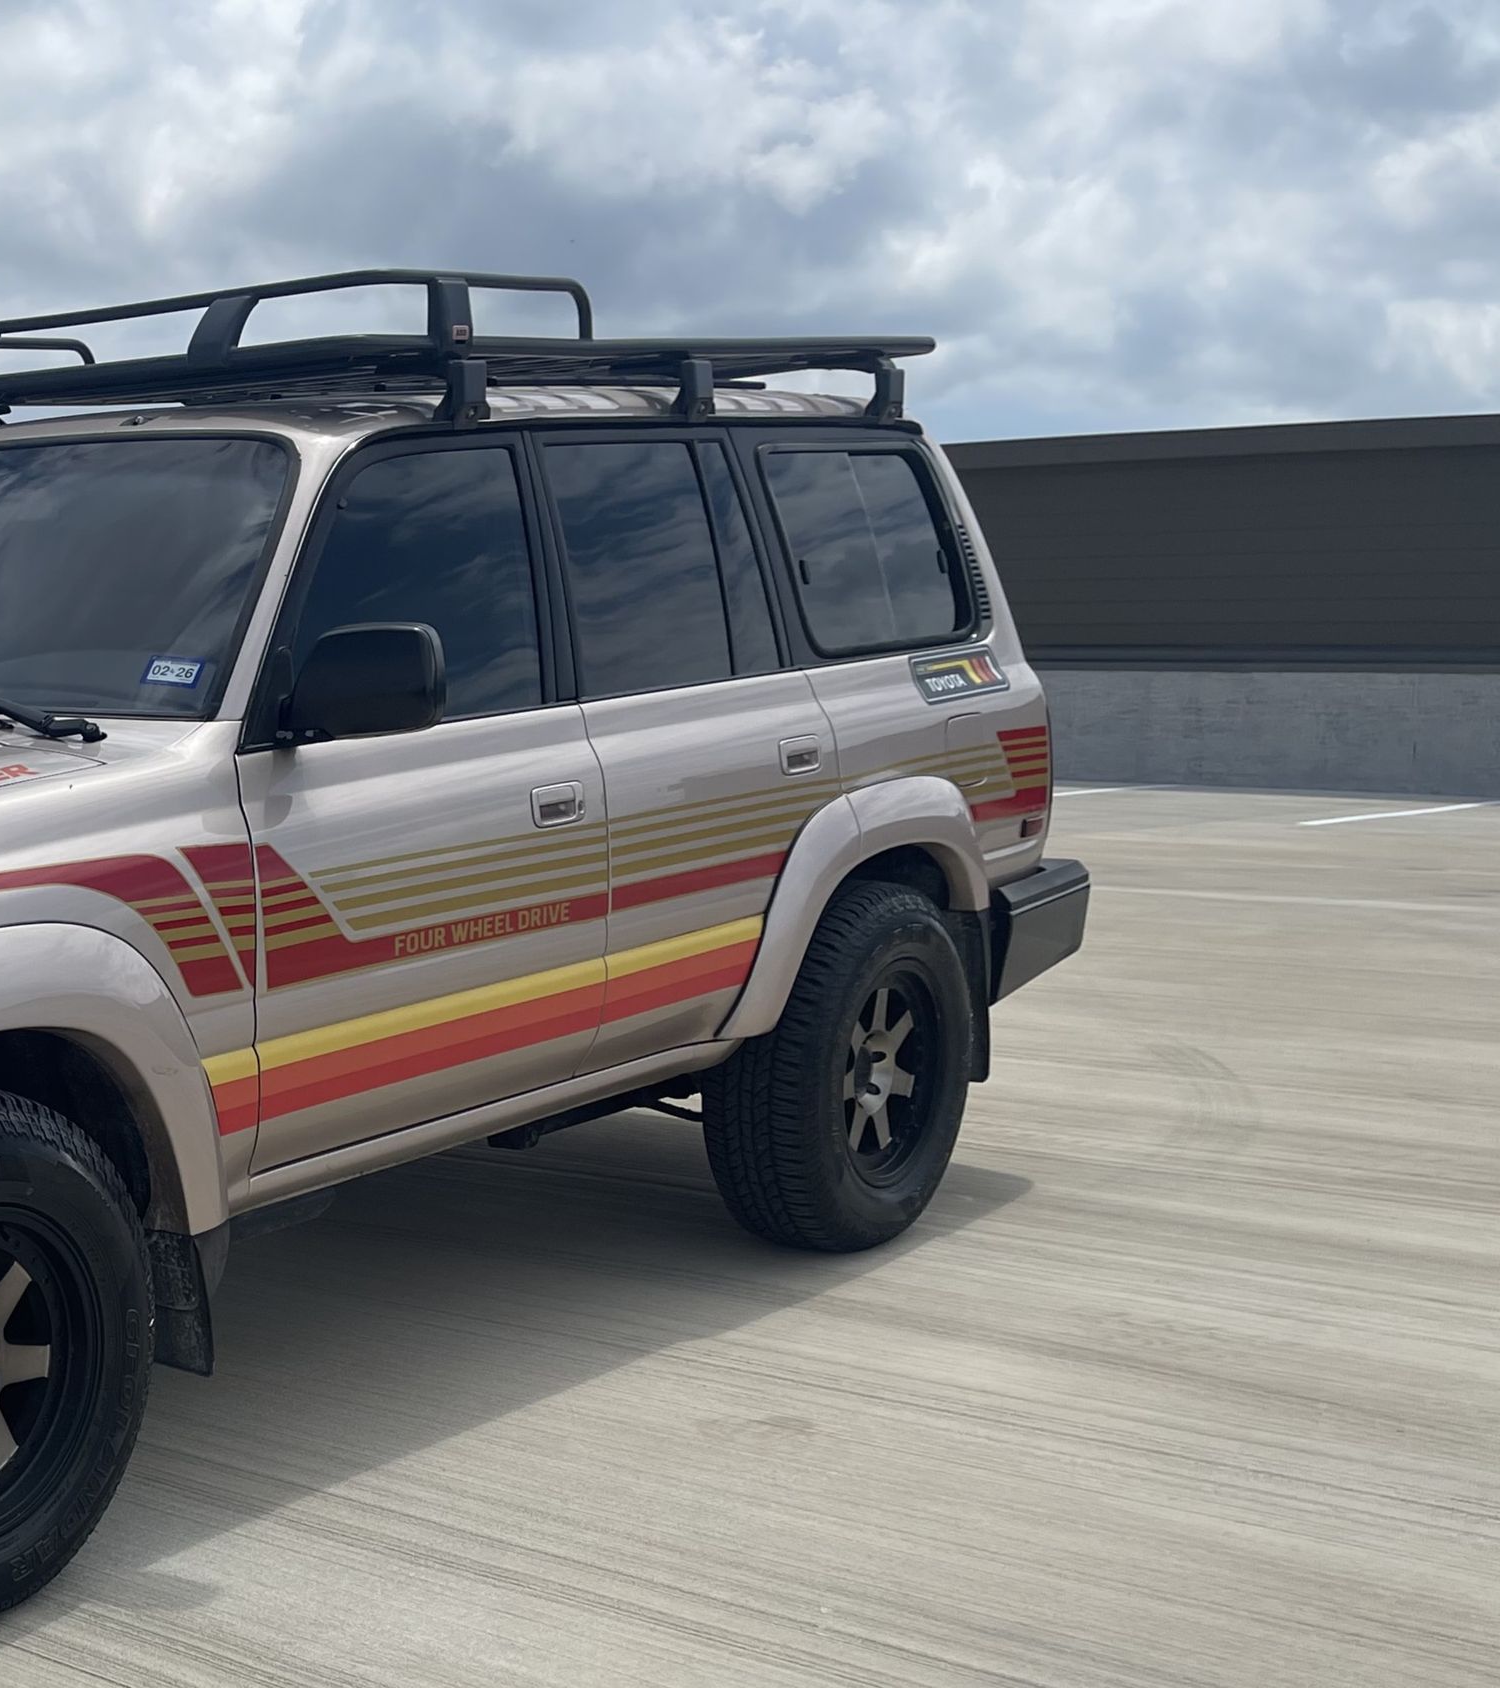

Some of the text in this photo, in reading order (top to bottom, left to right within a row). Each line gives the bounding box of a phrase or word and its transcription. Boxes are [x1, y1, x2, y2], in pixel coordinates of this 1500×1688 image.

[152, 664, 195, 679] 02 26
[924, 674, 968, 692] TOYOTA
[394, 903, 571, 956] FOUR WHEEL DRIVE
